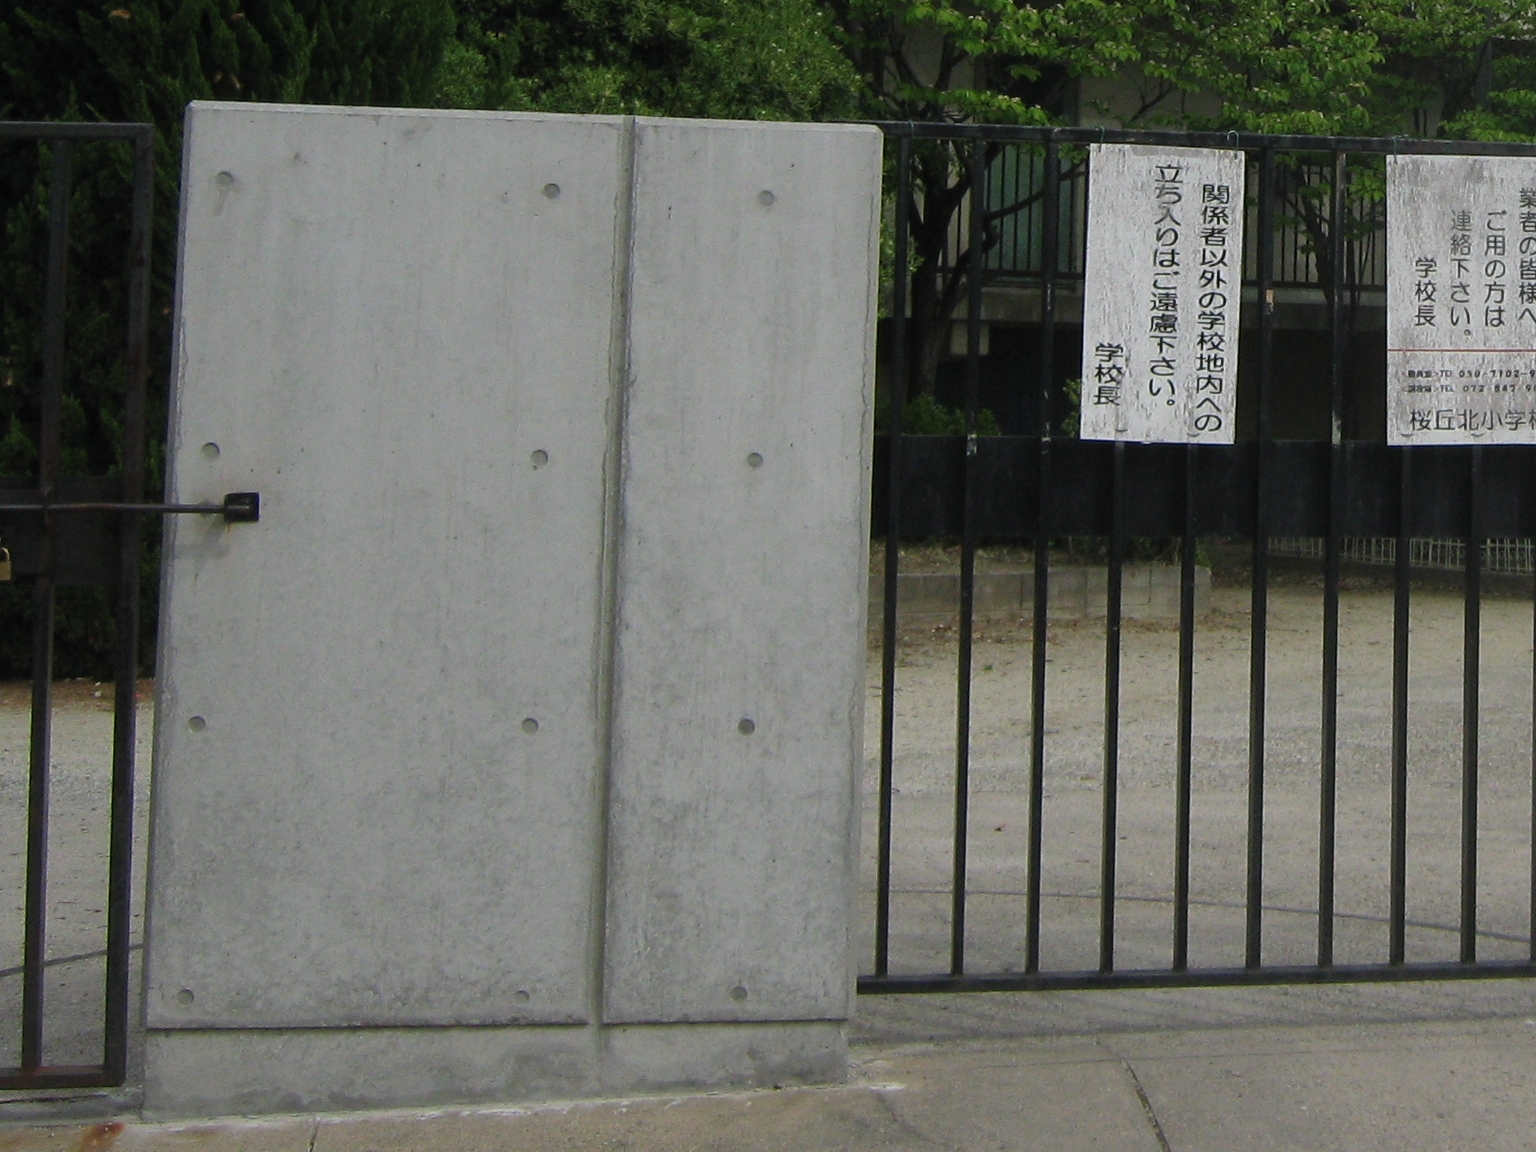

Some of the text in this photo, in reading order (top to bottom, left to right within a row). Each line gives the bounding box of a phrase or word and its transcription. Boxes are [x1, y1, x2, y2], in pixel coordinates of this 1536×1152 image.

[1148, 164, 1183, 407] 立ち入りはご遠慮下さい。
[1194, 183, 1230, 432] 関係者以外の学校地内への
[1414, 257, 1438, 328] 学校長
[1450, 209, 1472, 337] 連絡下さい。
[1484, 209, 1507, 328] ご用の方は
[1093, 342, 1124, 407] 学校長
